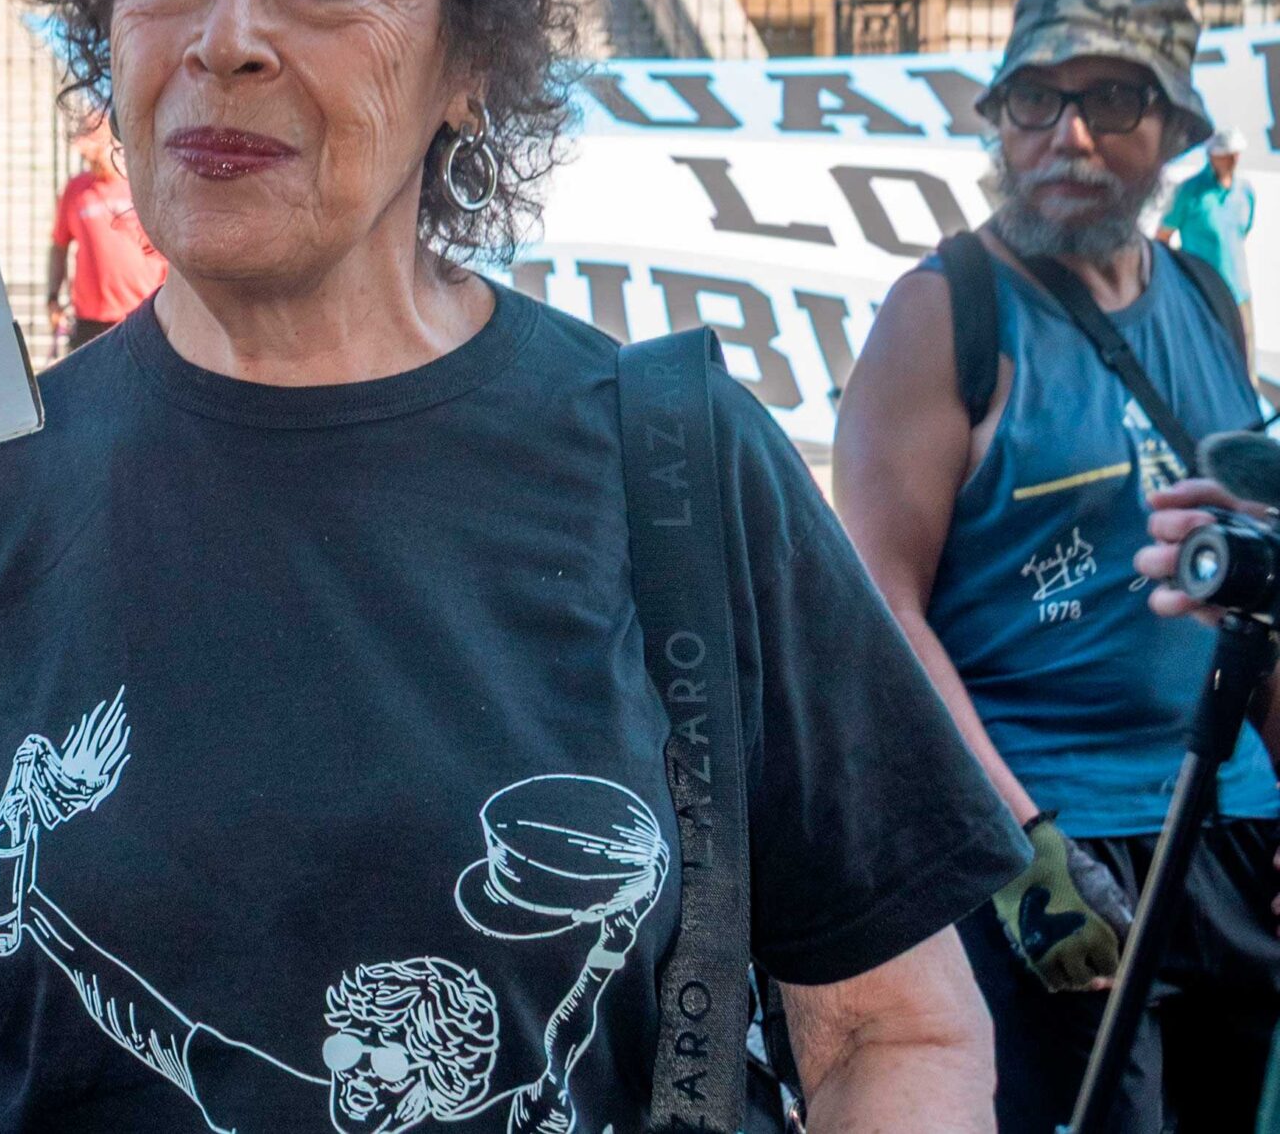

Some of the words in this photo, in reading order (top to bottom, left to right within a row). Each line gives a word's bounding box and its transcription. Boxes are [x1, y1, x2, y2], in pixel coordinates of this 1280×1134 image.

[670, 154, 1005, 260] LO
[643, 358, 693, 527] LAZAR
[1038, 599, 1082, 623] 1978
[665, 630, 712, 868] LAZARO
